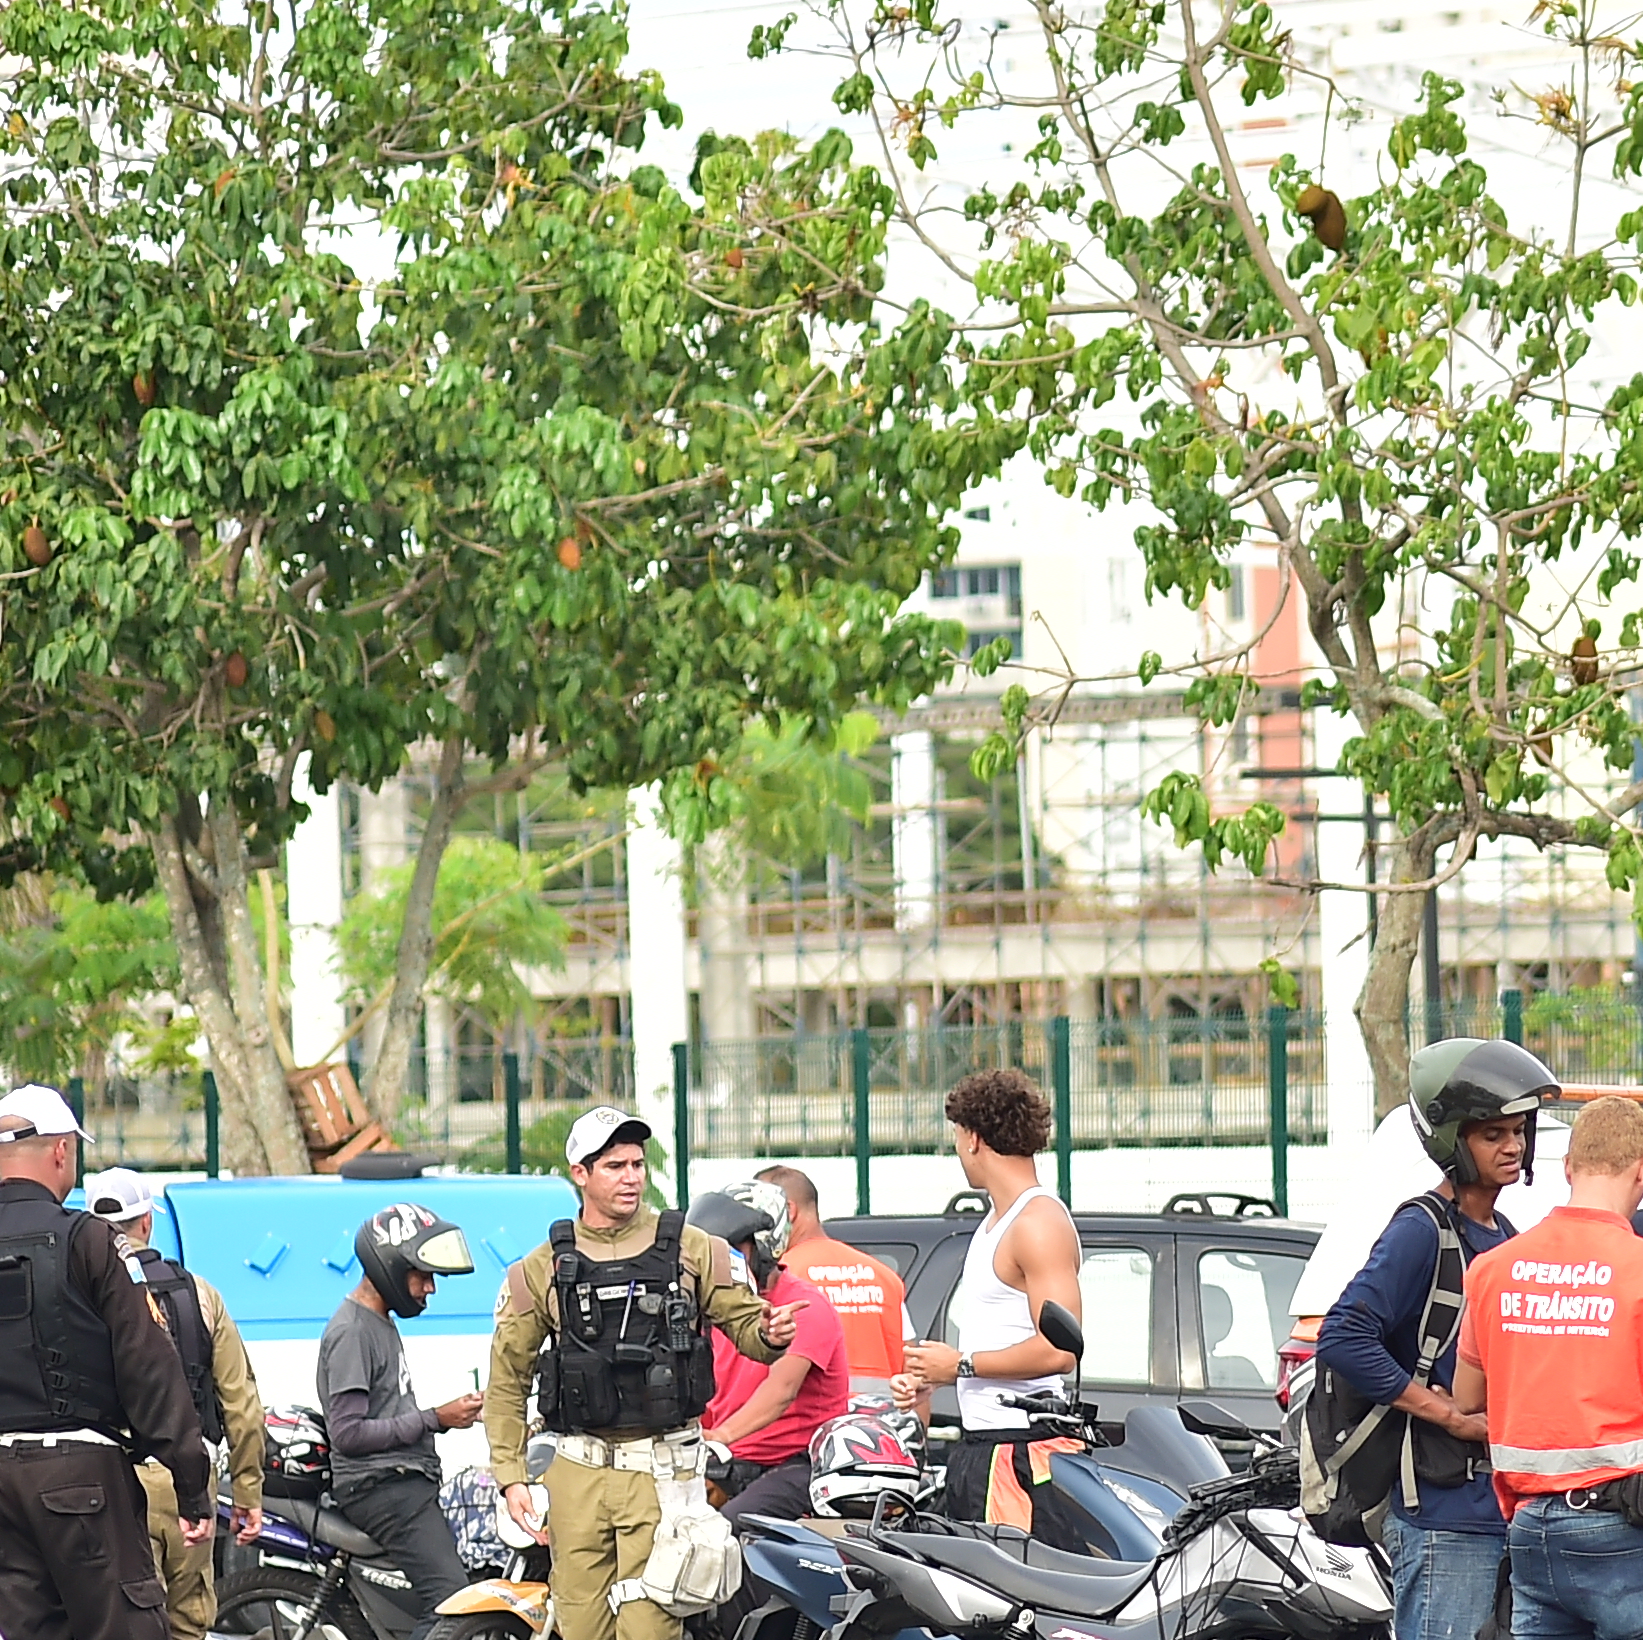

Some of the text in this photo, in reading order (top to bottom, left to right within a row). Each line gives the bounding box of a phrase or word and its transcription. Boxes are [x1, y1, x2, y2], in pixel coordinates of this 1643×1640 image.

[1511, 1260, 1612, 1289] OPERAÇÃO
[1500, 1290, 1615, 1322] DE TRÂNSITO
[1315, 1566, 1352, 1581] HONDA
